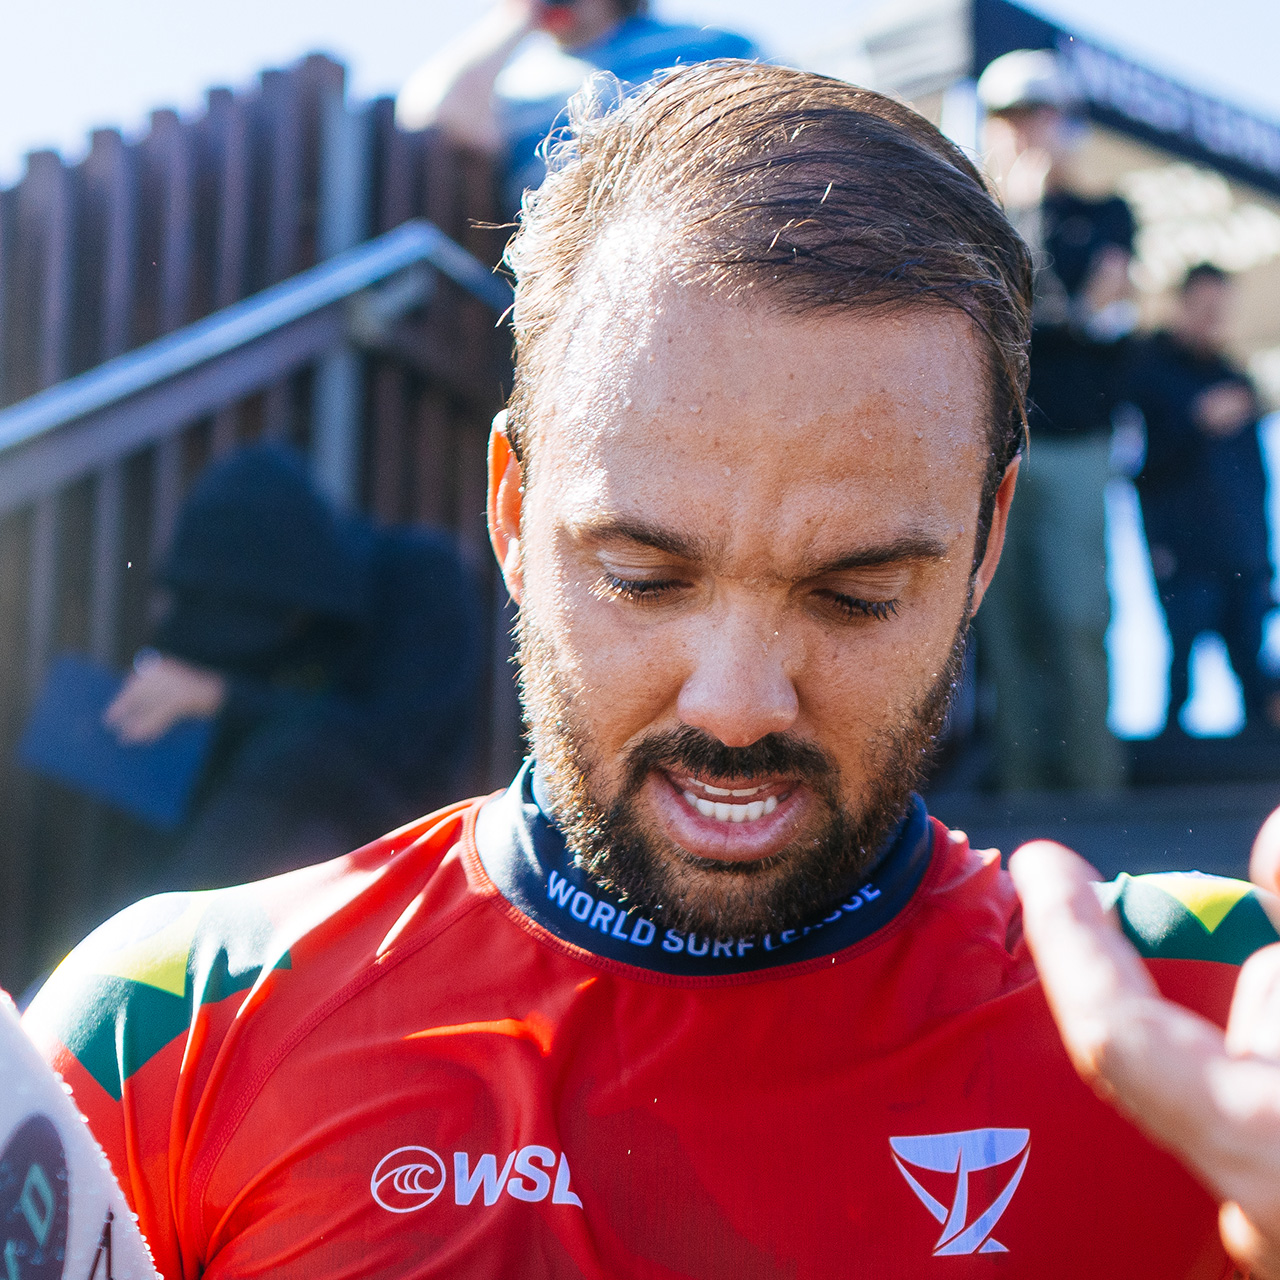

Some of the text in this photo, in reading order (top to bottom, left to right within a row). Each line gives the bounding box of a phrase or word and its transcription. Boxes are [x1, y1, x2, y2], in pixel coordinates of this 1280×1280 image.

[547, 870, 657, 946] WORLD
[661, 929, 755, 957] SURF
[454, 1145, 583, 1209] WSL
